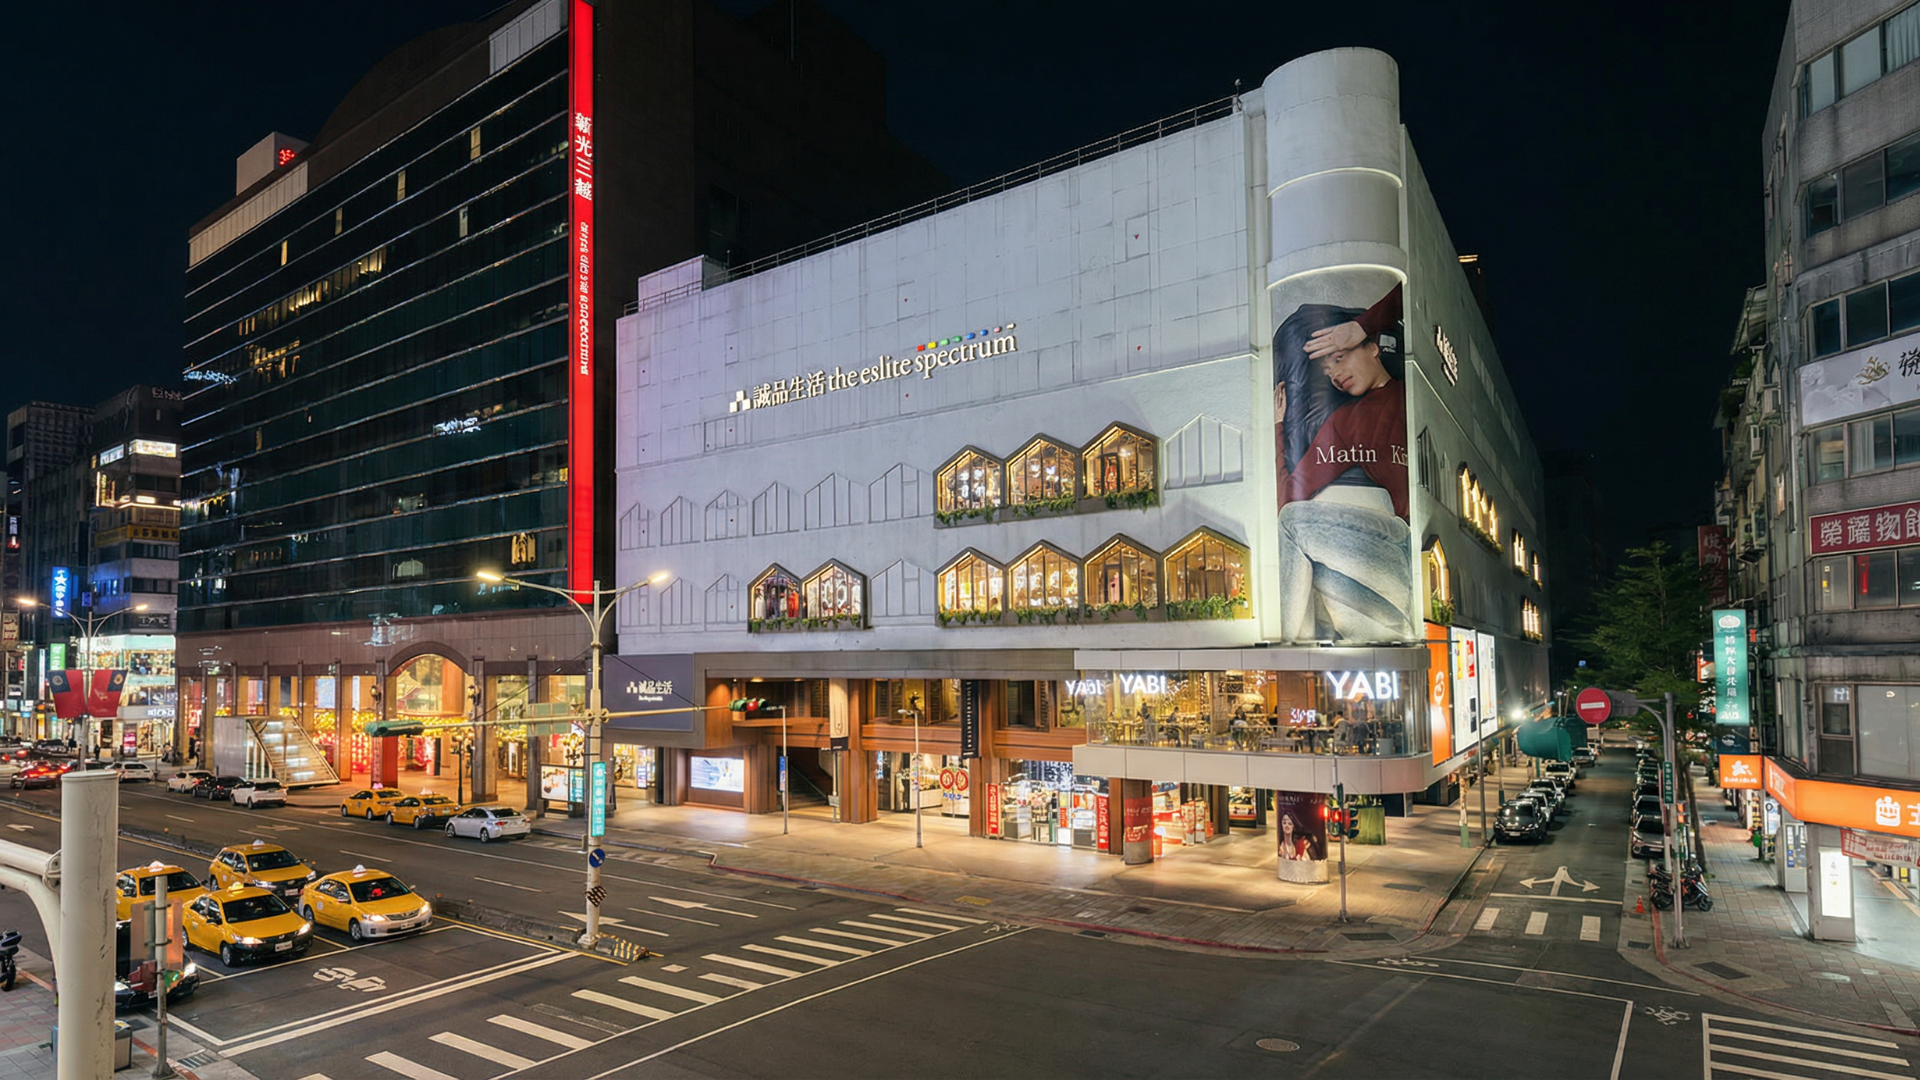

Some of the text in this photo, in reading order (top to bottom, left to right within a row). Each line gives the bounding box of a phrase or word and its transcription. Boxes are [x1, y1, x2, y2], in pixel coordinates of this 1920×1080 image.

[752, 335, 1017, 409] 誠品生活 the eslite spectrum
[1315, 443, 1378, 465] Matin
[1119, 673, 1167, 695] YABI
[1326, 670, 1400, 700] YABI
